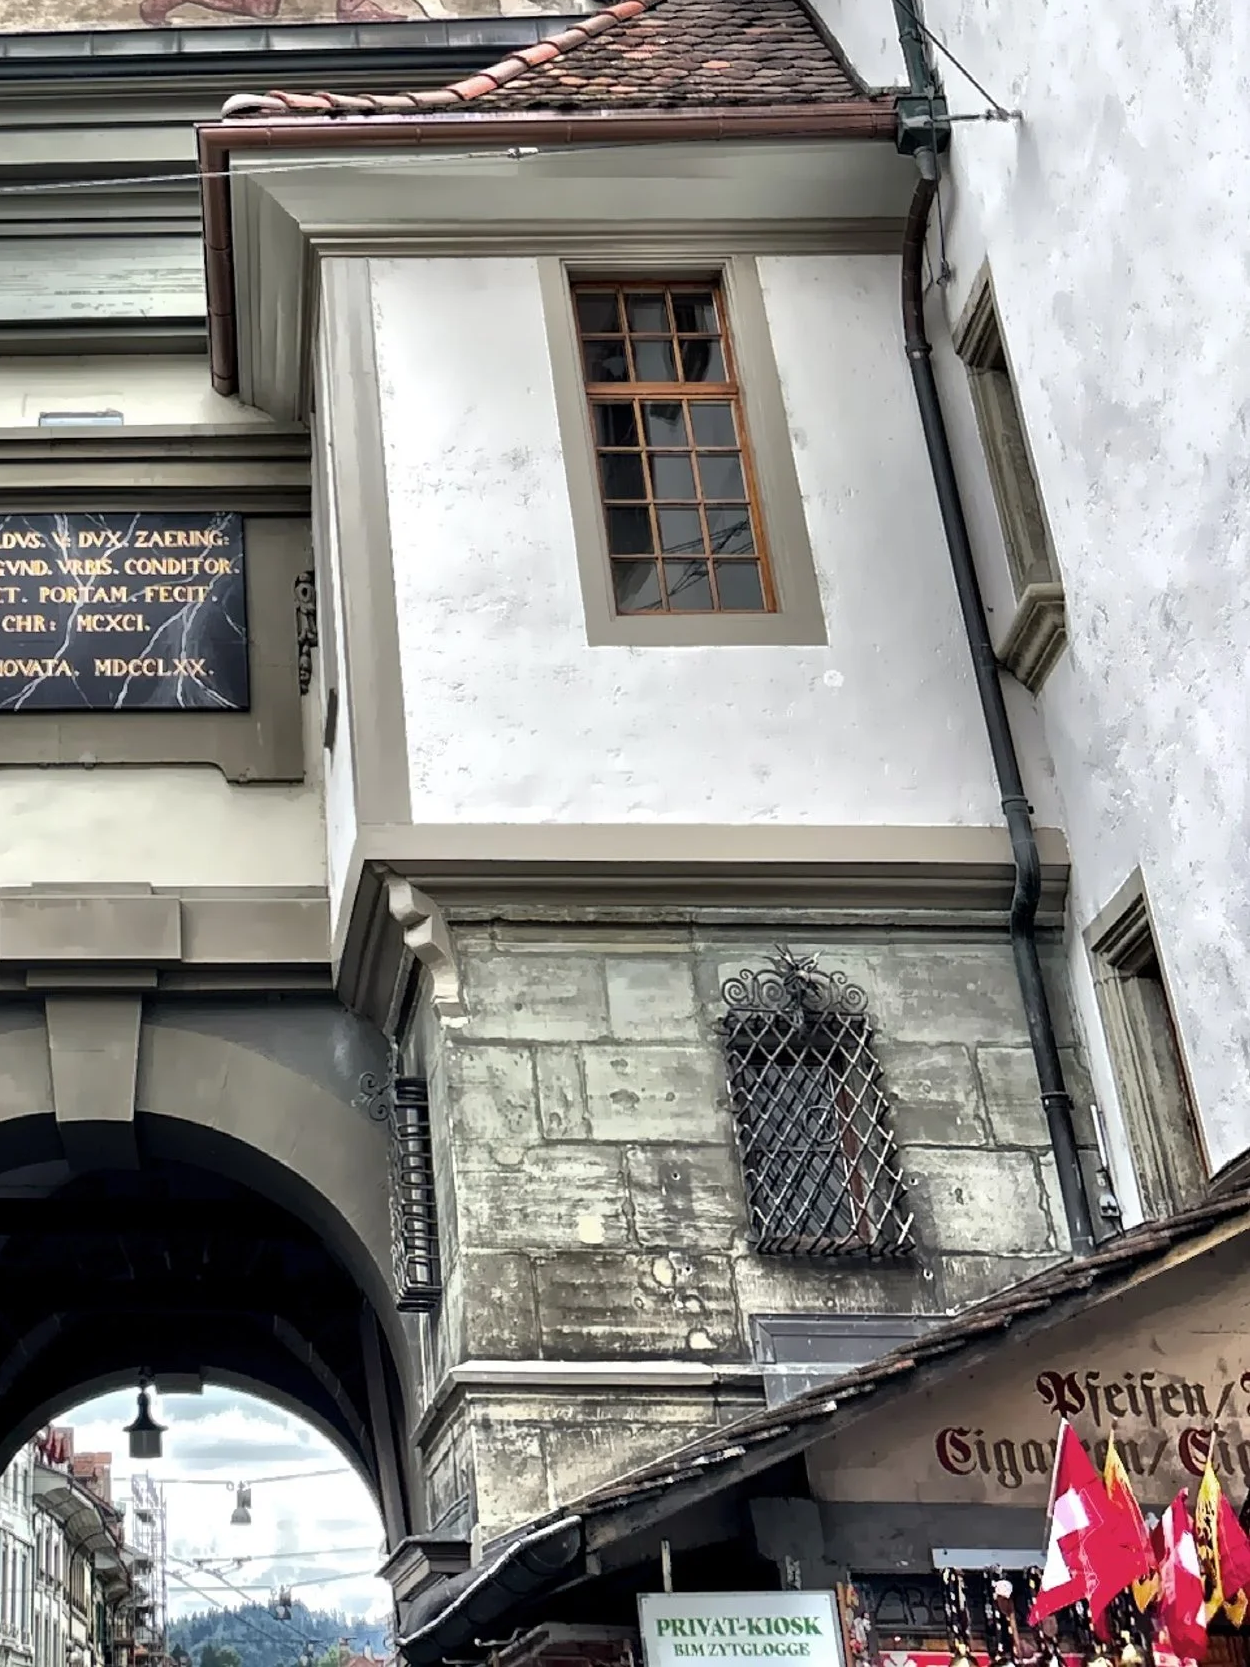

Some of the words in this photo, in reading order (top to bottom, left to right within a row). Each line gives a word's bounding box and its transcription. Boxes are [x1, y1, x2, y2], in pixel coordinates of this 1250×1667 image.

[134, 530, 230, 549] ZAERING:
[124, 557, 240, 576] CONDITOR.
[1, 614, 57, 633] CHR:
[76, 613, 151, 632] MCXCI.
[656, 1616, 823, 1638] PRIVAT-KIOSK
[674, 1643, 706, 1657] BIM
[707, 1642, 811, 1657] ZYTGLOGGE
